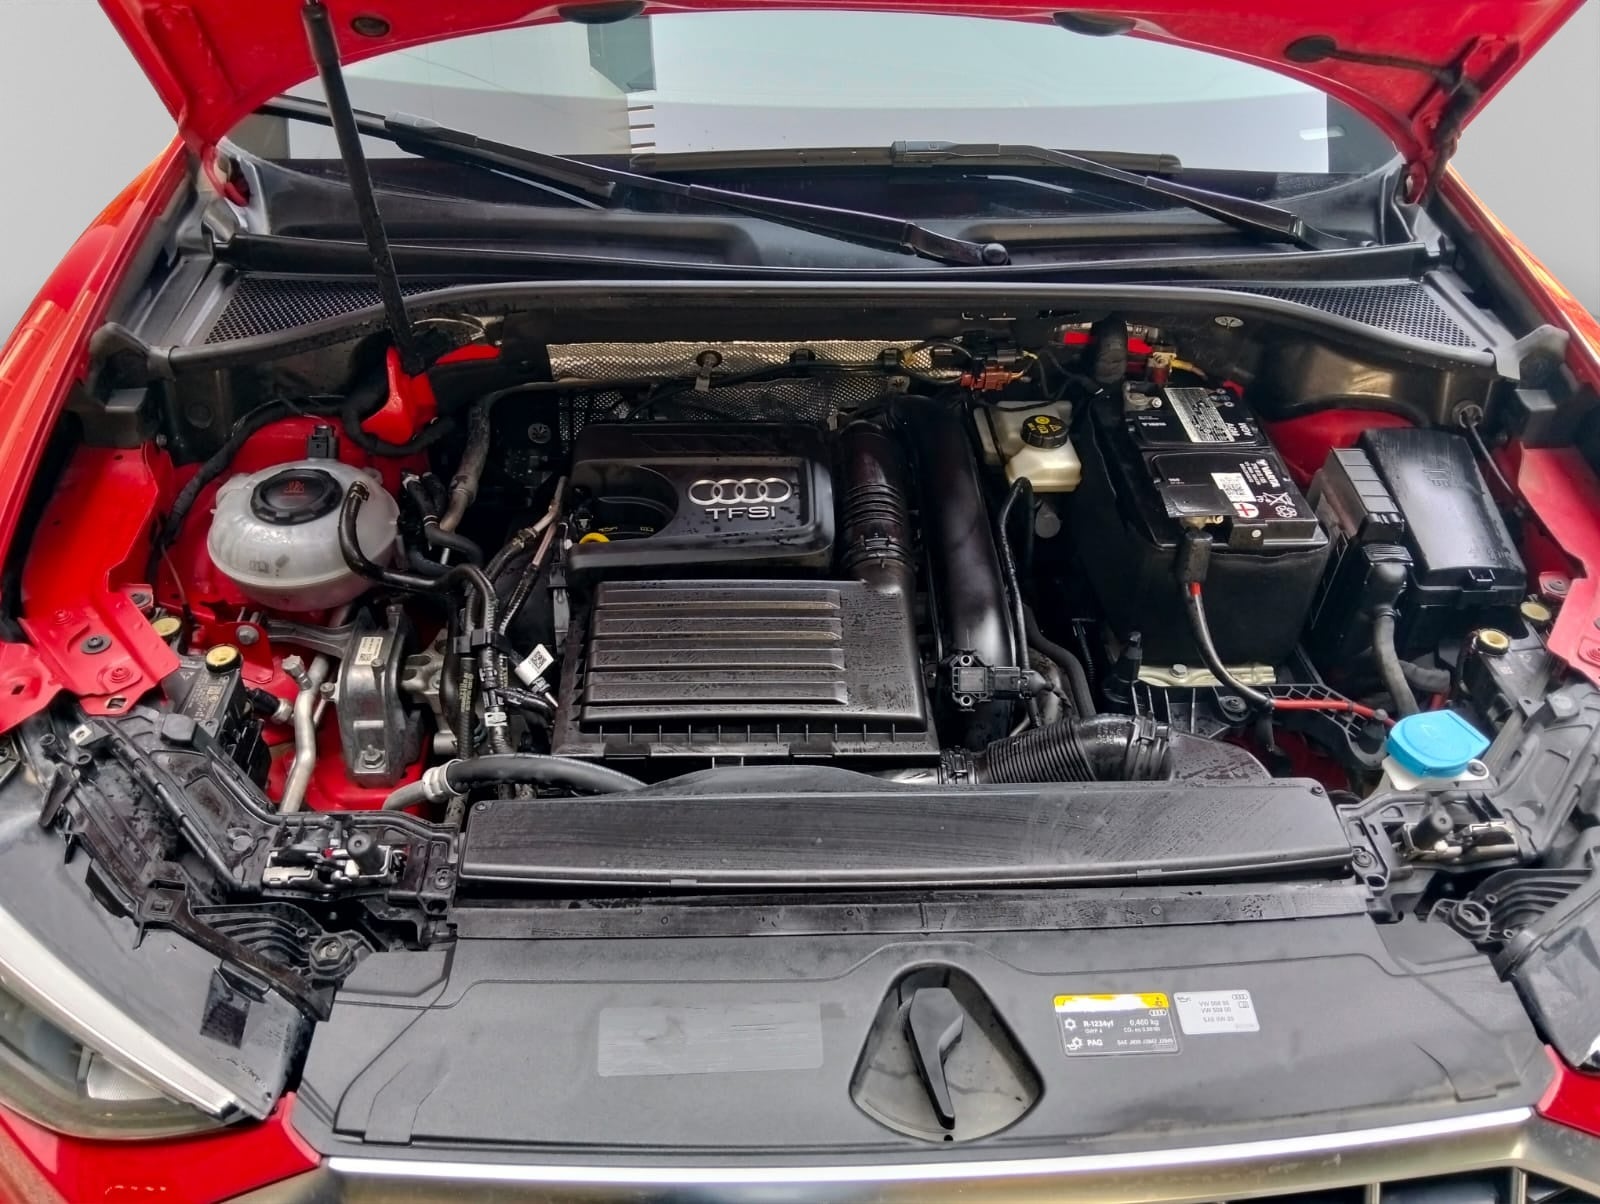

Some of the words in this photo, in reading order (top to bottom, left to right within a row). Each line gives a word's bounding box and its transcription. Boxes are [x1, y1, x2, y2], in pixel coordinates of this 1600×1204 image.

[705, 506, 776, 520] TFSI
[1083, 1020, 1114, 1029] R-1234yf
[1150, 1018, 1160, 1026] kg
[1087, 1038, 1104, 1047] PAG
